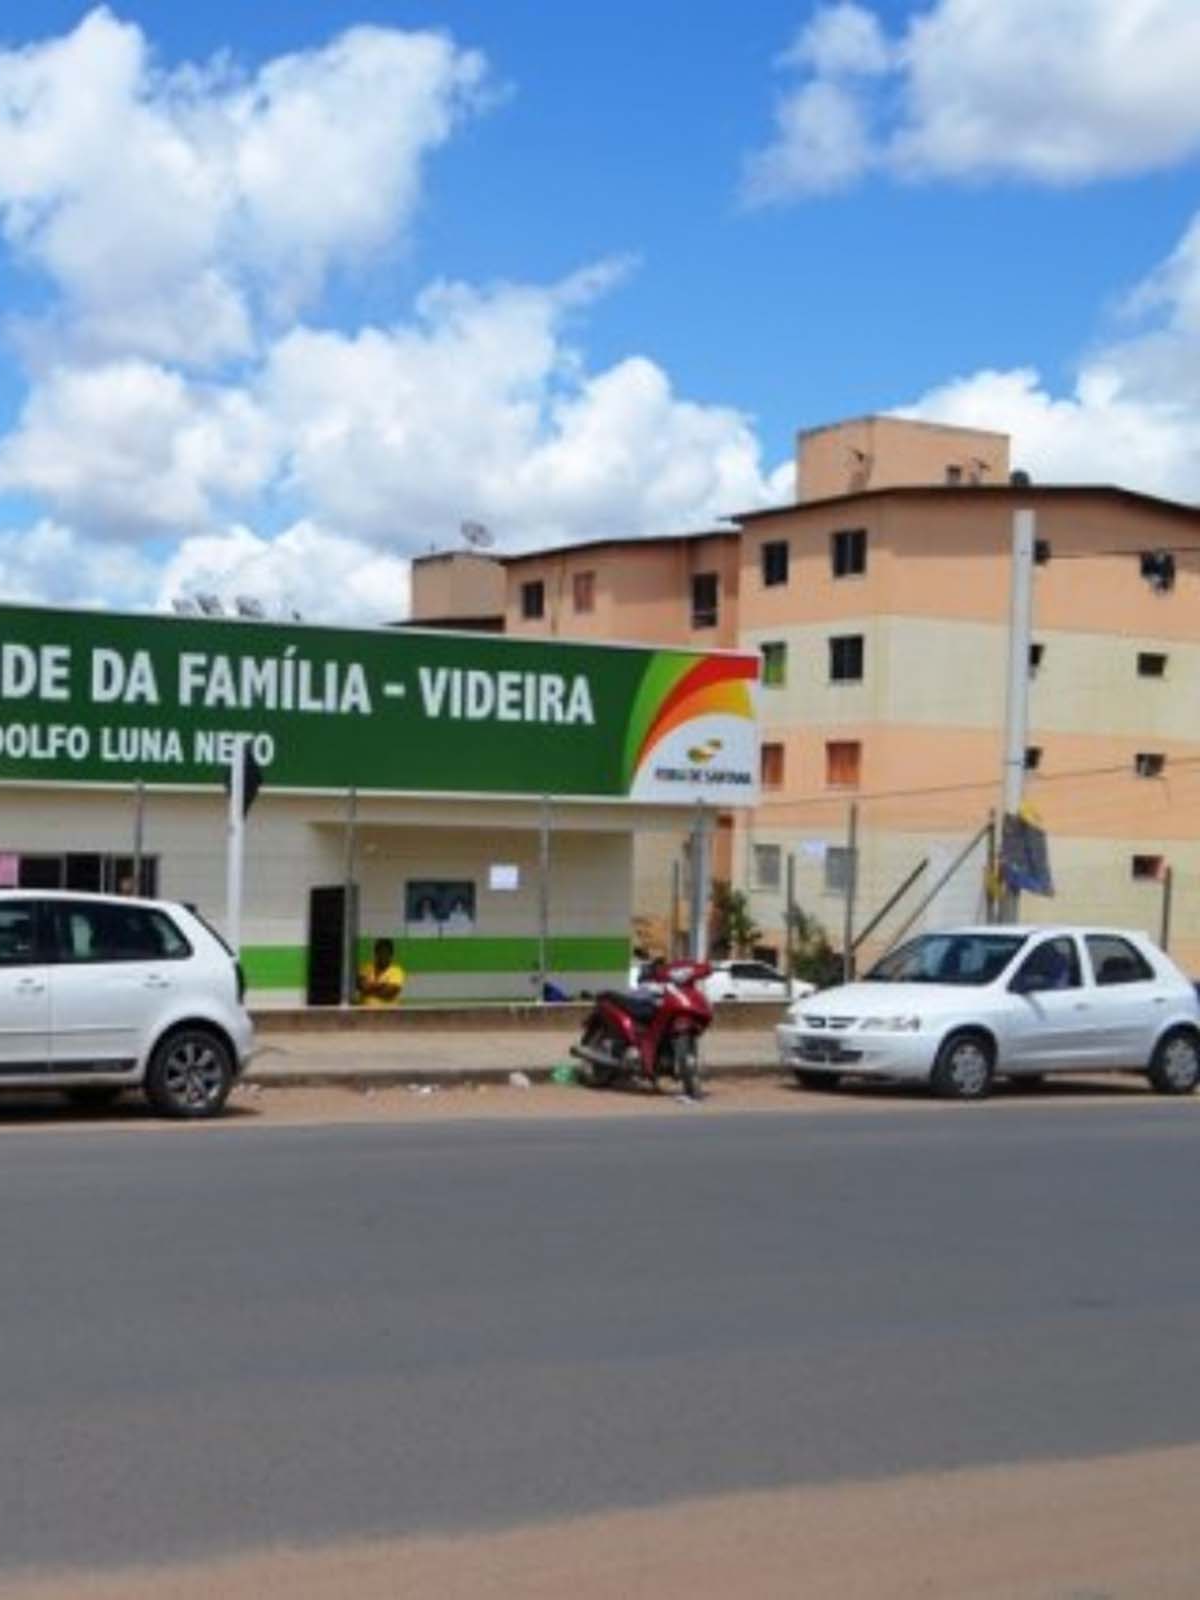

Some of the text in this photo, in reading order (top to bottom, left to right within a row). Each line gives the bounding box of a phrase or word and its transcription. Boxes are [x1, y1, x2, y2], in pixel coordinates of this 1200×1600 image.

[91, 649, 159, 704] DA
[178, 645, 371, 714] FAMÍLIA
[383, 683, 406, 697] -
[419, 667, 595, 725] VIDEIRA
[101, 727, 184, 763] LUNA
